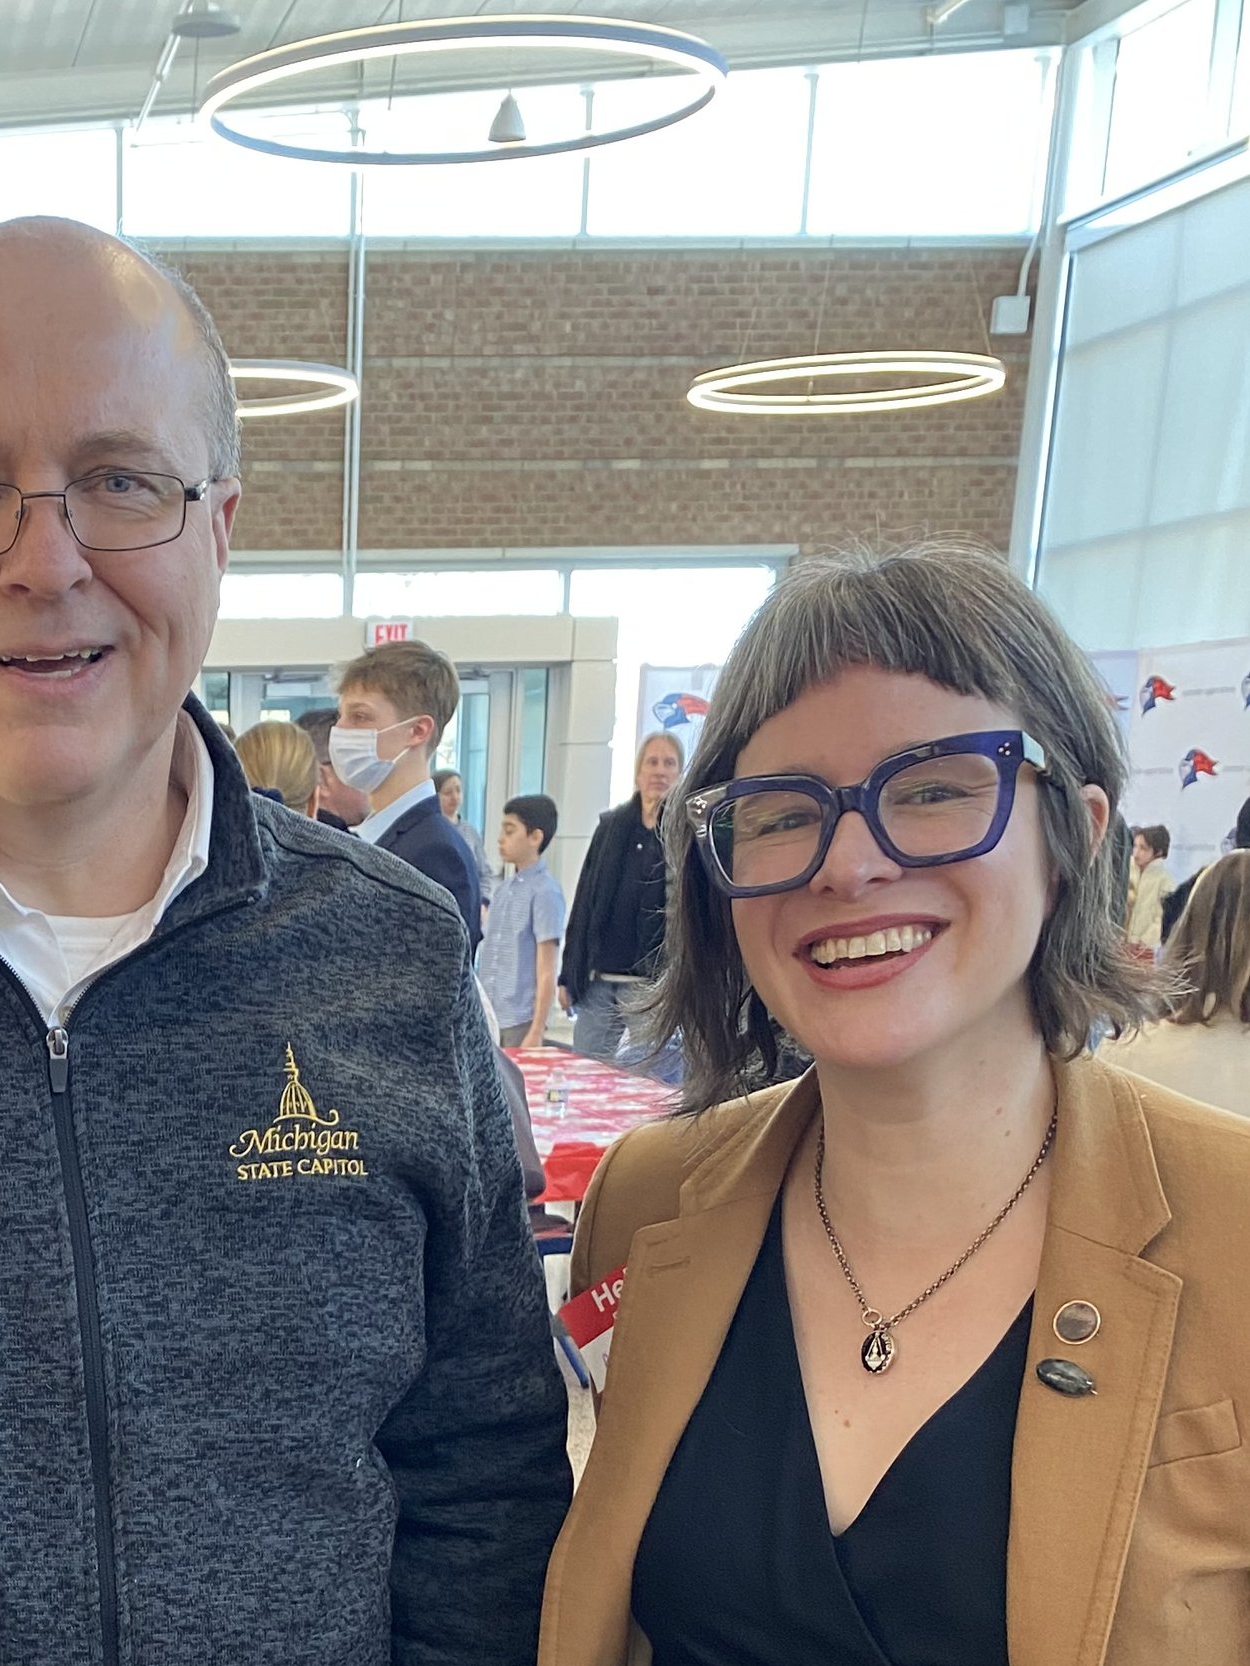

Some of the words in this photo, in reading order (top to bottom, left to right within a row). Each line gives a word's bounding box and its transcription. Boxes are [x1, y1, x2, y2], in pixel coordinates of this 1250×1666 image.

[375, 624, 408, 645] EXIT
[229, 1123, 359, 1157] Michigan
[237, 1160, 293, 1180] STATE
[296, 1158, 369, 1176] CAPITOL
